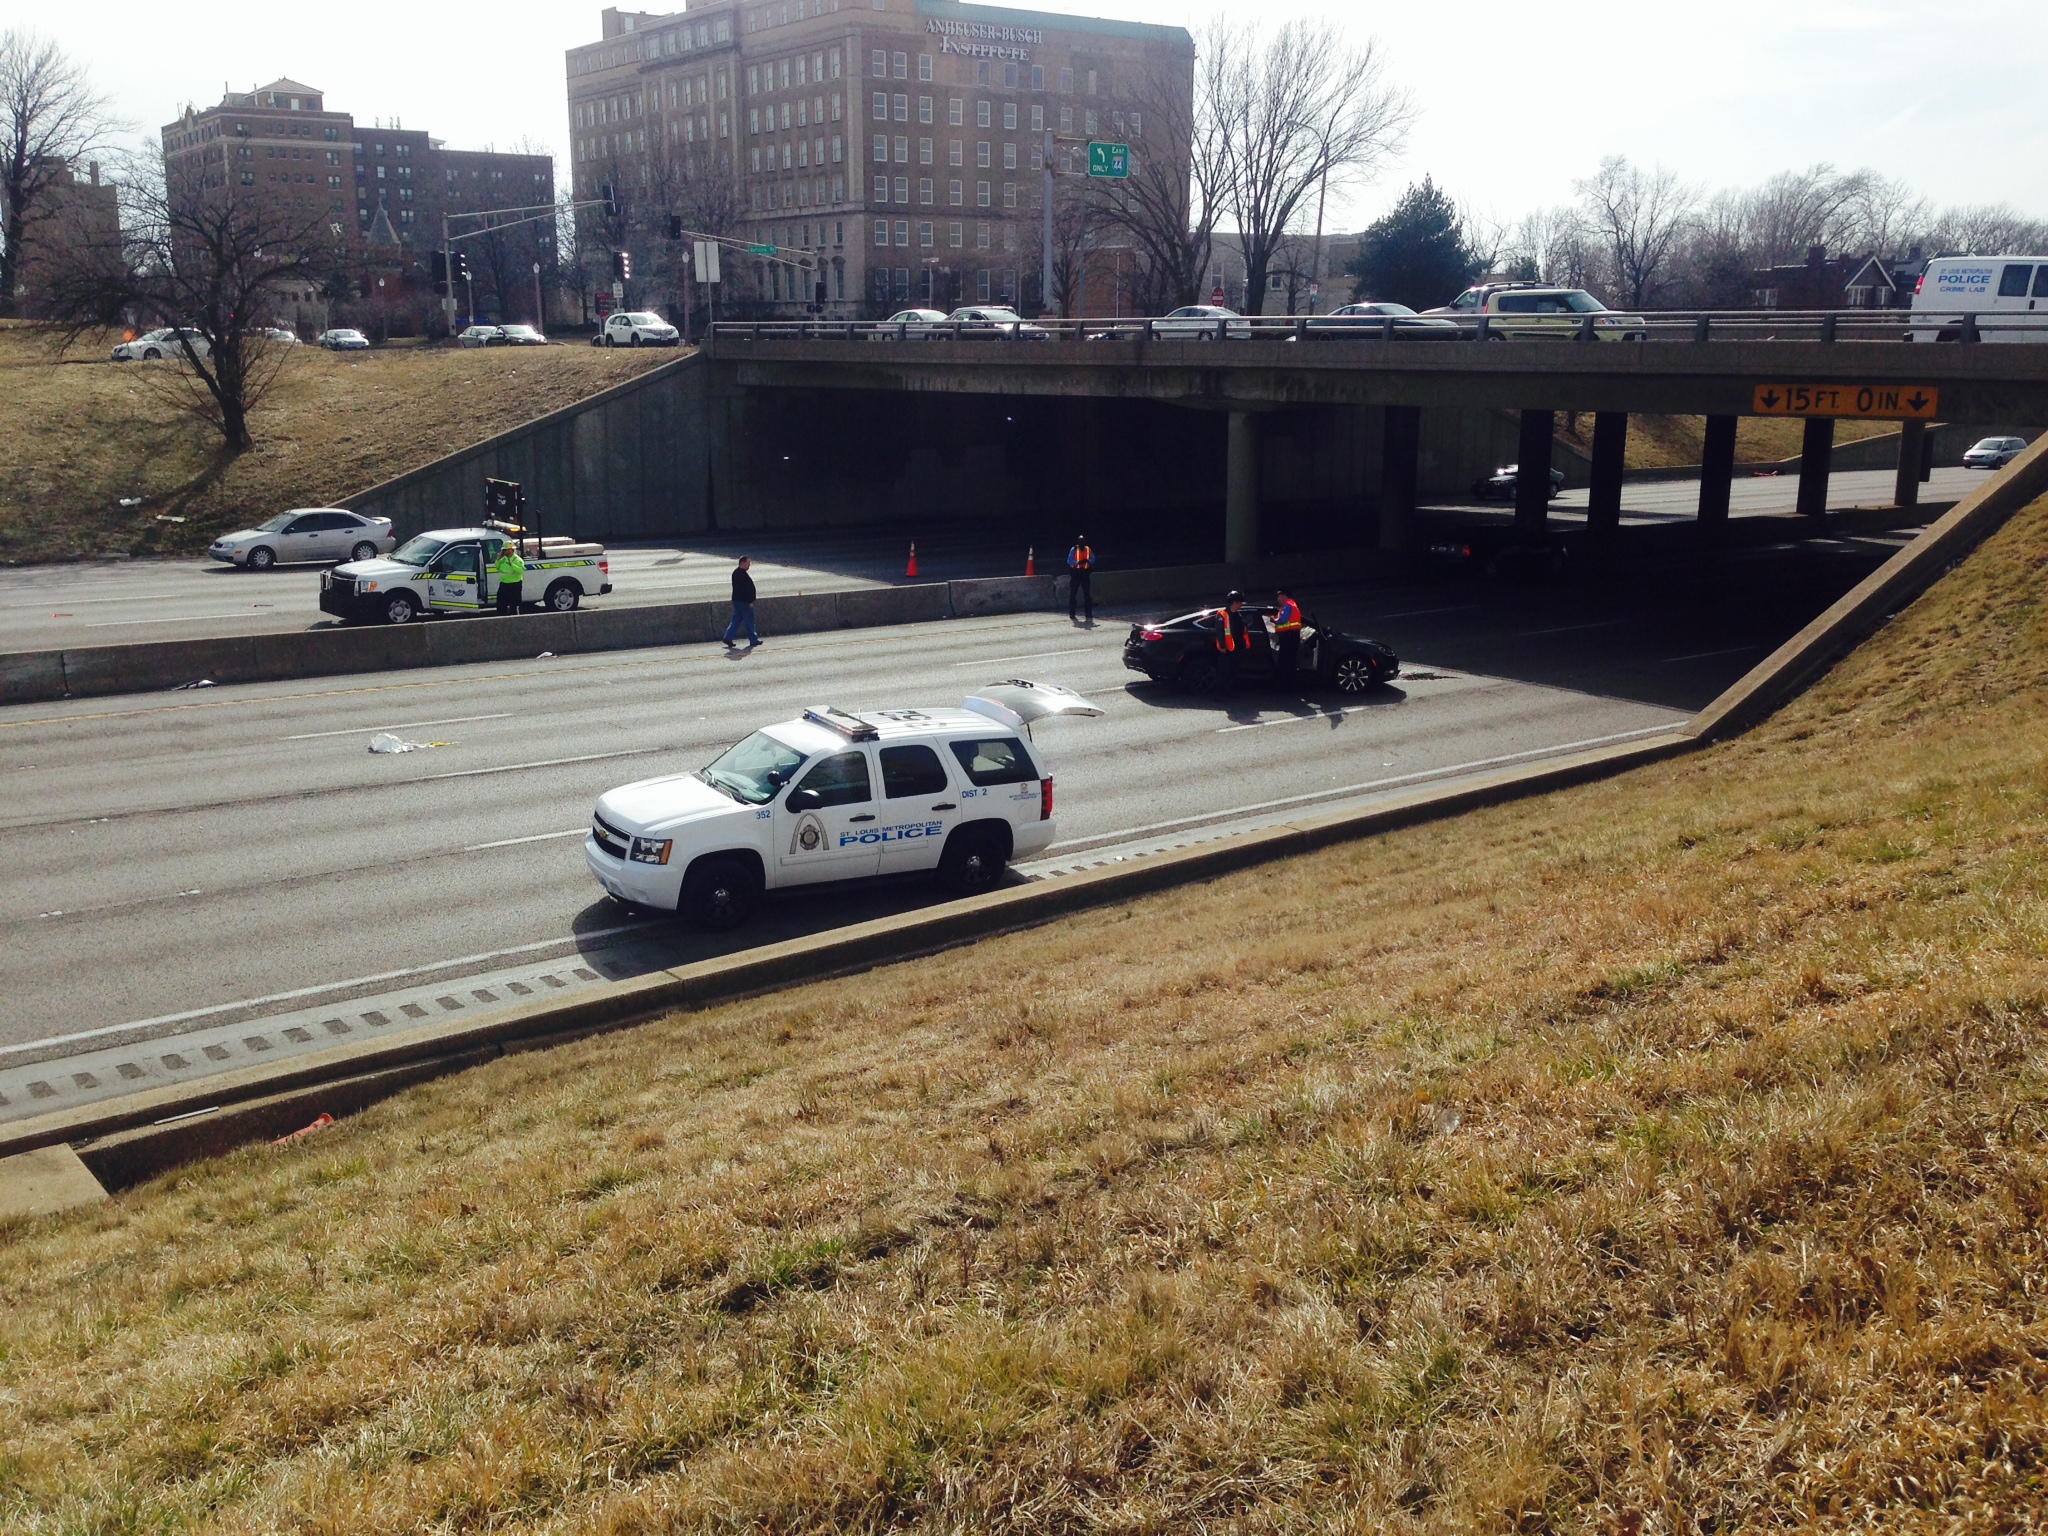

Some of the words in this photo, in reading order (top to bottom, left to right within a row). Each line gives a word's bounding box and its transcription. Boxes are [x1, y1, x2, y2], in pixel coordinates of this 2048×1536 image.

[926, 19, 1042, 44] ANHEUSER-BUSCH
[939, 36, 1030, 61] INSTITUTE
[1092, 164, 1109, 173] ONLY
[1113, 161, 1122, 169] 44
[1938, 275, 1991, 284] POLICE
[1856, 387, 1874, 413] 0
[961, 788, 978, 799] DIST
[981, 787, 988, 796] 2
[755, 810, 771, 820] 352
[855, 827, 880, 835] LOUIS
[881, 820, 943, 832] METROPOLITAN
[839, 825, 942, 847] POLICE
